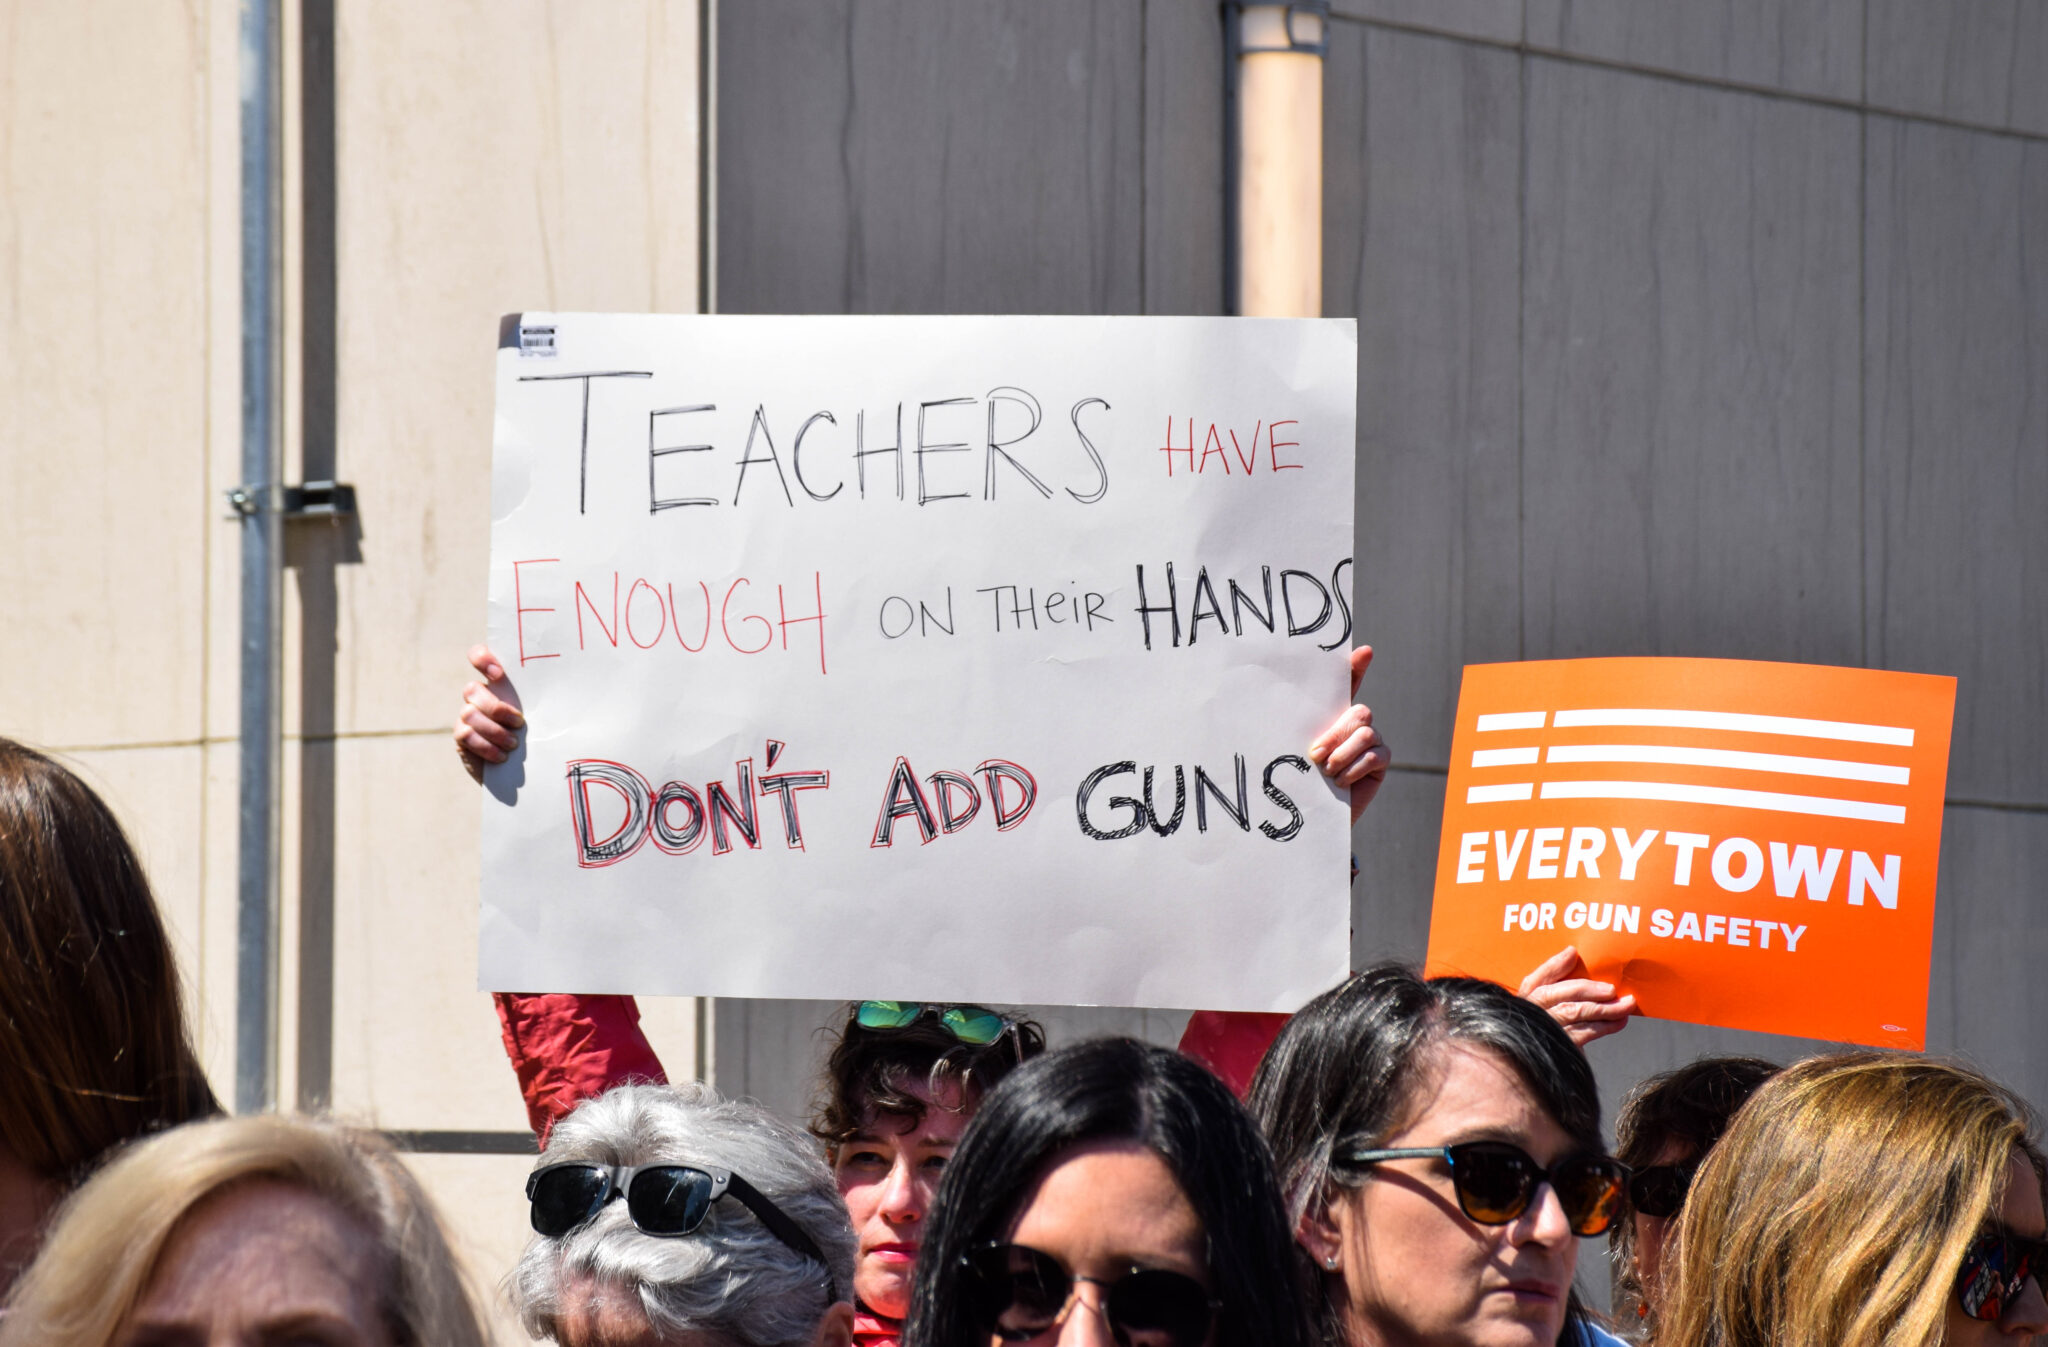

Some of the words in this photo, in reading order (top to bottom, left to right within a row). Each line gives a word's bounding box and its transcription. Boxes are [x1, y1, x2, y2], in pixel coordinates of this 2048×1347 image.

[517, 371, 1111, 515] TEACHERS
[1159, 415, 1304, 478] HAVE
[513, 558, 828, 675] ENOUGH
[880, 586, 954, 639] ON
[1135, 557, 1354, 652] HANDS
[565, 739, 830, 869] DON'T
[870, 755, 1039, 849] ADD
[1075, 752, 1312, 843] GUNS
[1456, 826, 1901, 910] EVERYTOWN
[1503, 904, 1555, 931] FOR
[1564, 902, 1640, 934] GUN
[1650, 908, 1807, 952] SAFETY
